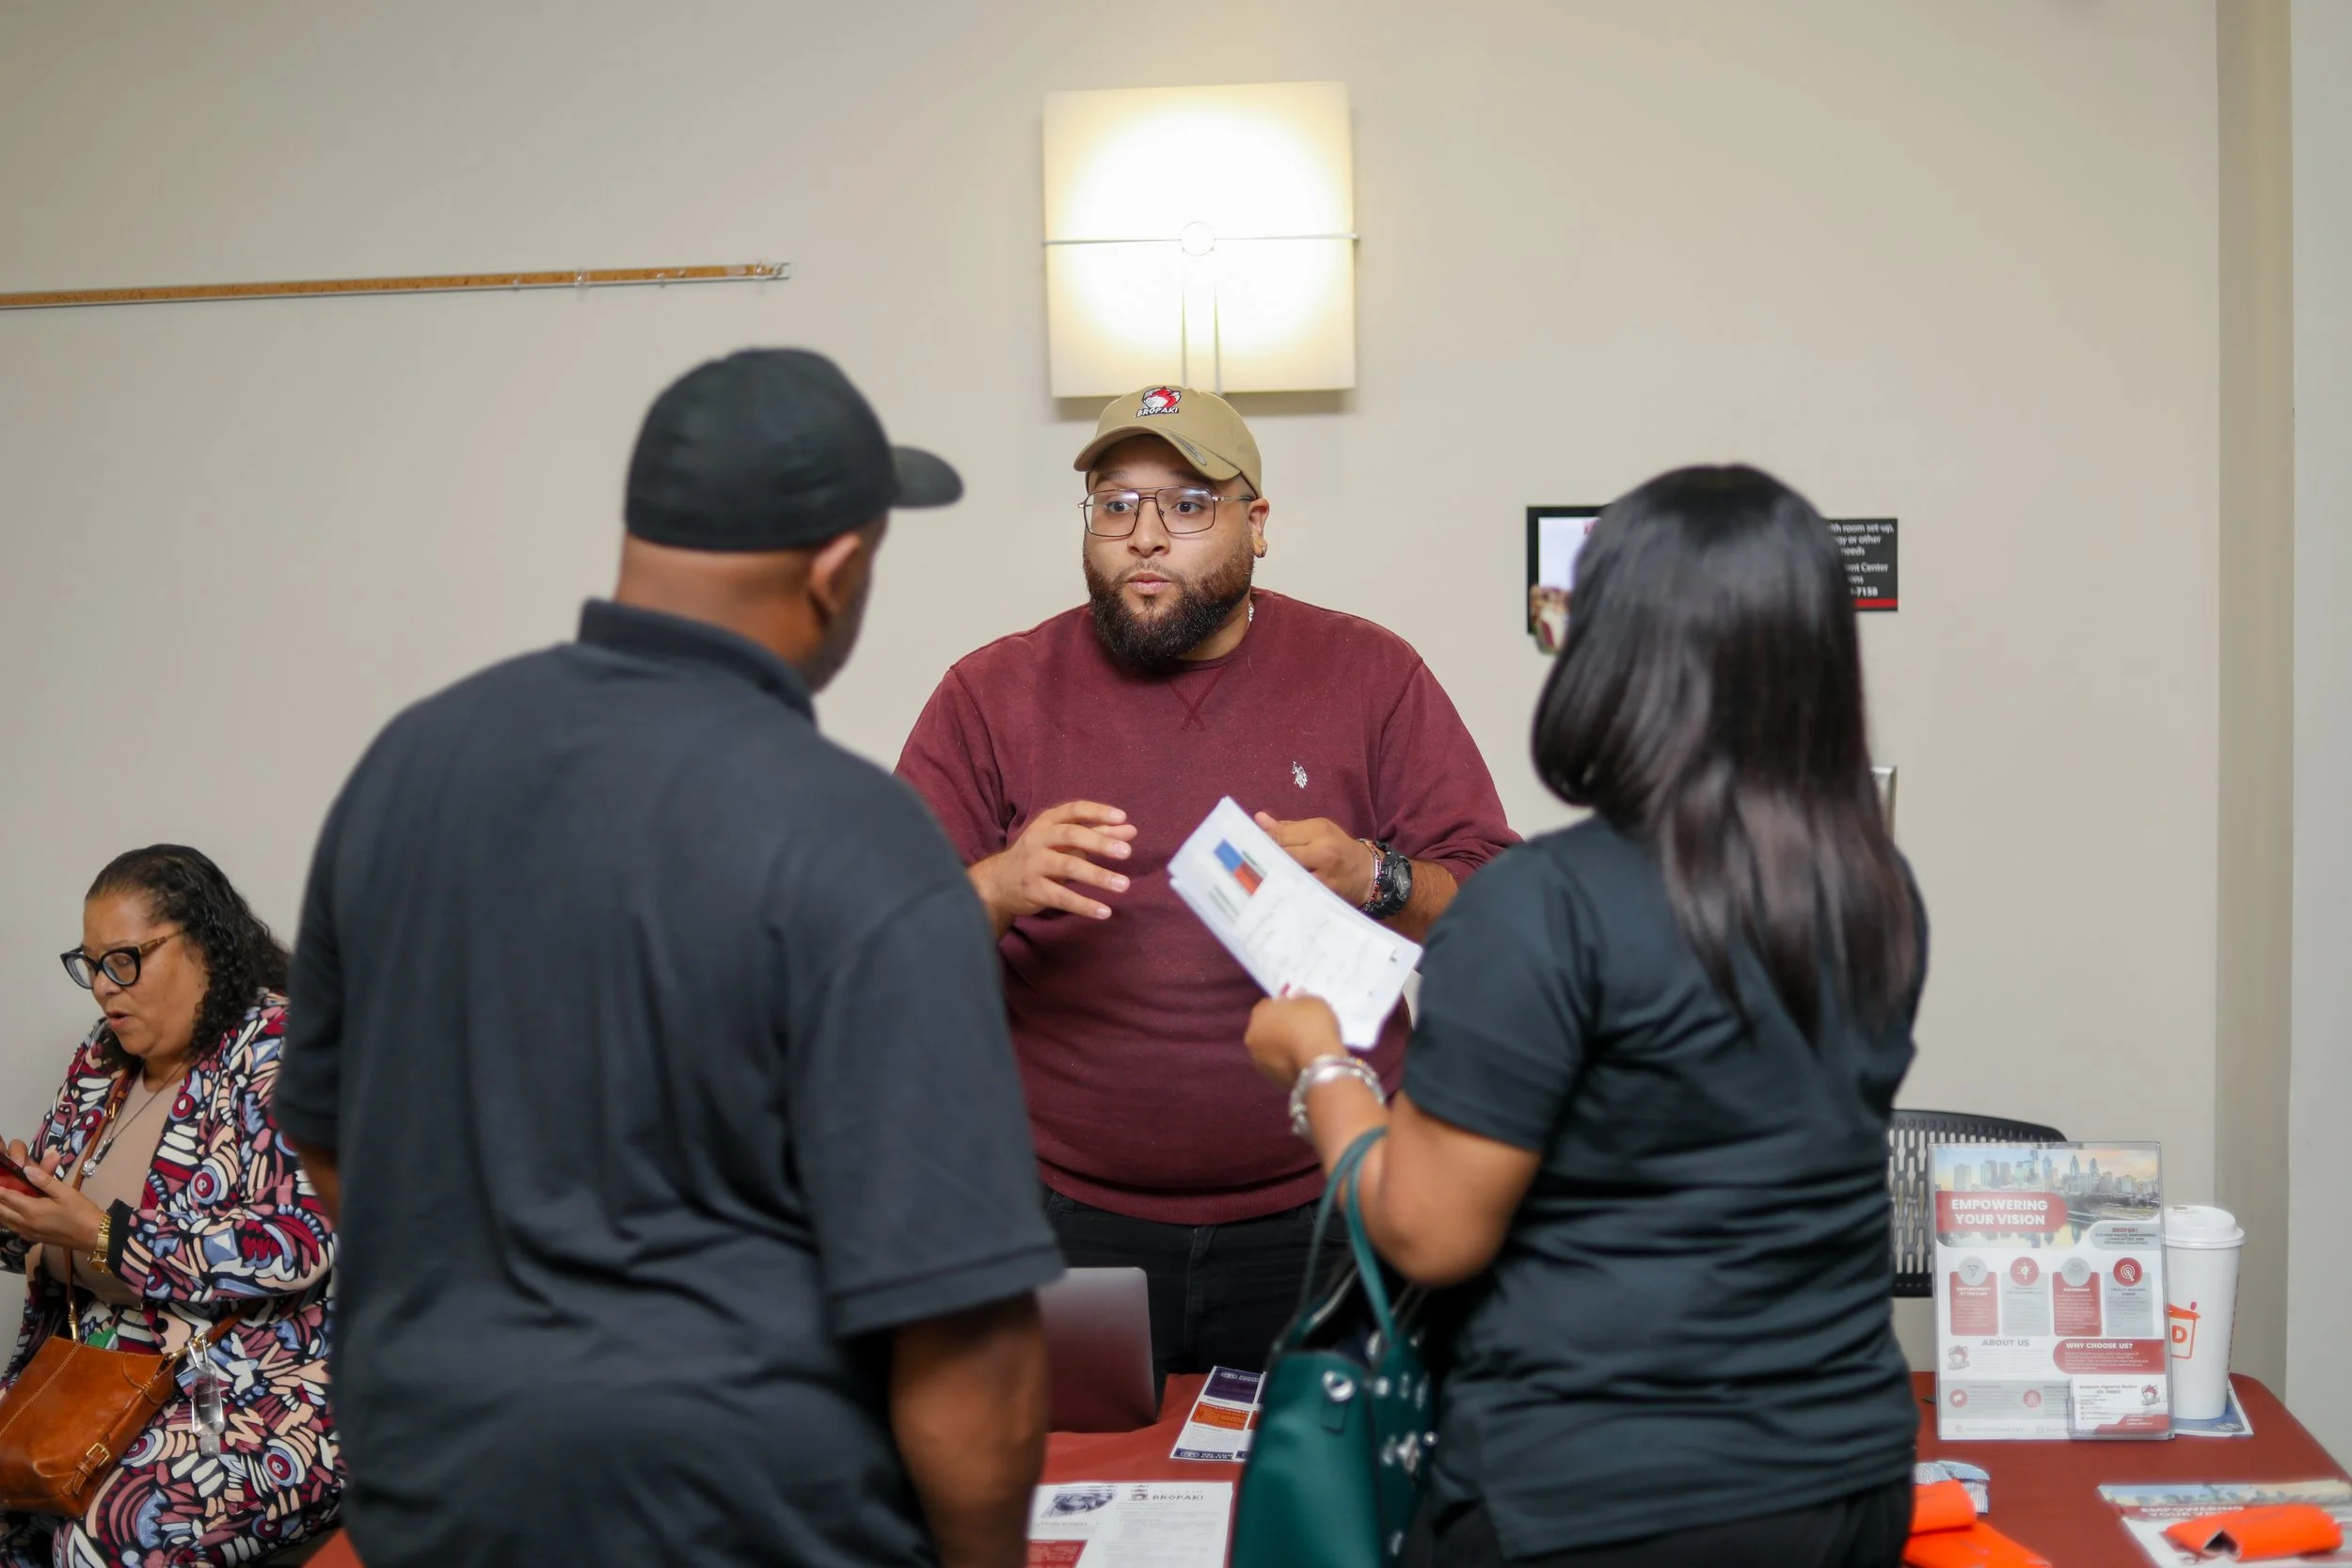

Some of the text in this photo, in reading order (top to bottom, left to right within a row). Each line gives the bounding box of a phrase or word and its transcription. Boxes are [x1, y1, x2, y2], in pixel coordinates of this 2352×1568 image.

[1136, 406, 1178, 417] BROPAKI
[1842, 524, 1865, 533] room
[1848, 536, 1857, 545] or
[1857, 534, 1882, 545] other
[1841, 546, 1866, 556] needs
[1860, 562, 1889, 573] Center
[1951, 1198, 2048, 1211] EMPOWERING
[1955, 1213, 2045, 1226] YOUR VISION
[2171, 1324, 2187, 1343] D
